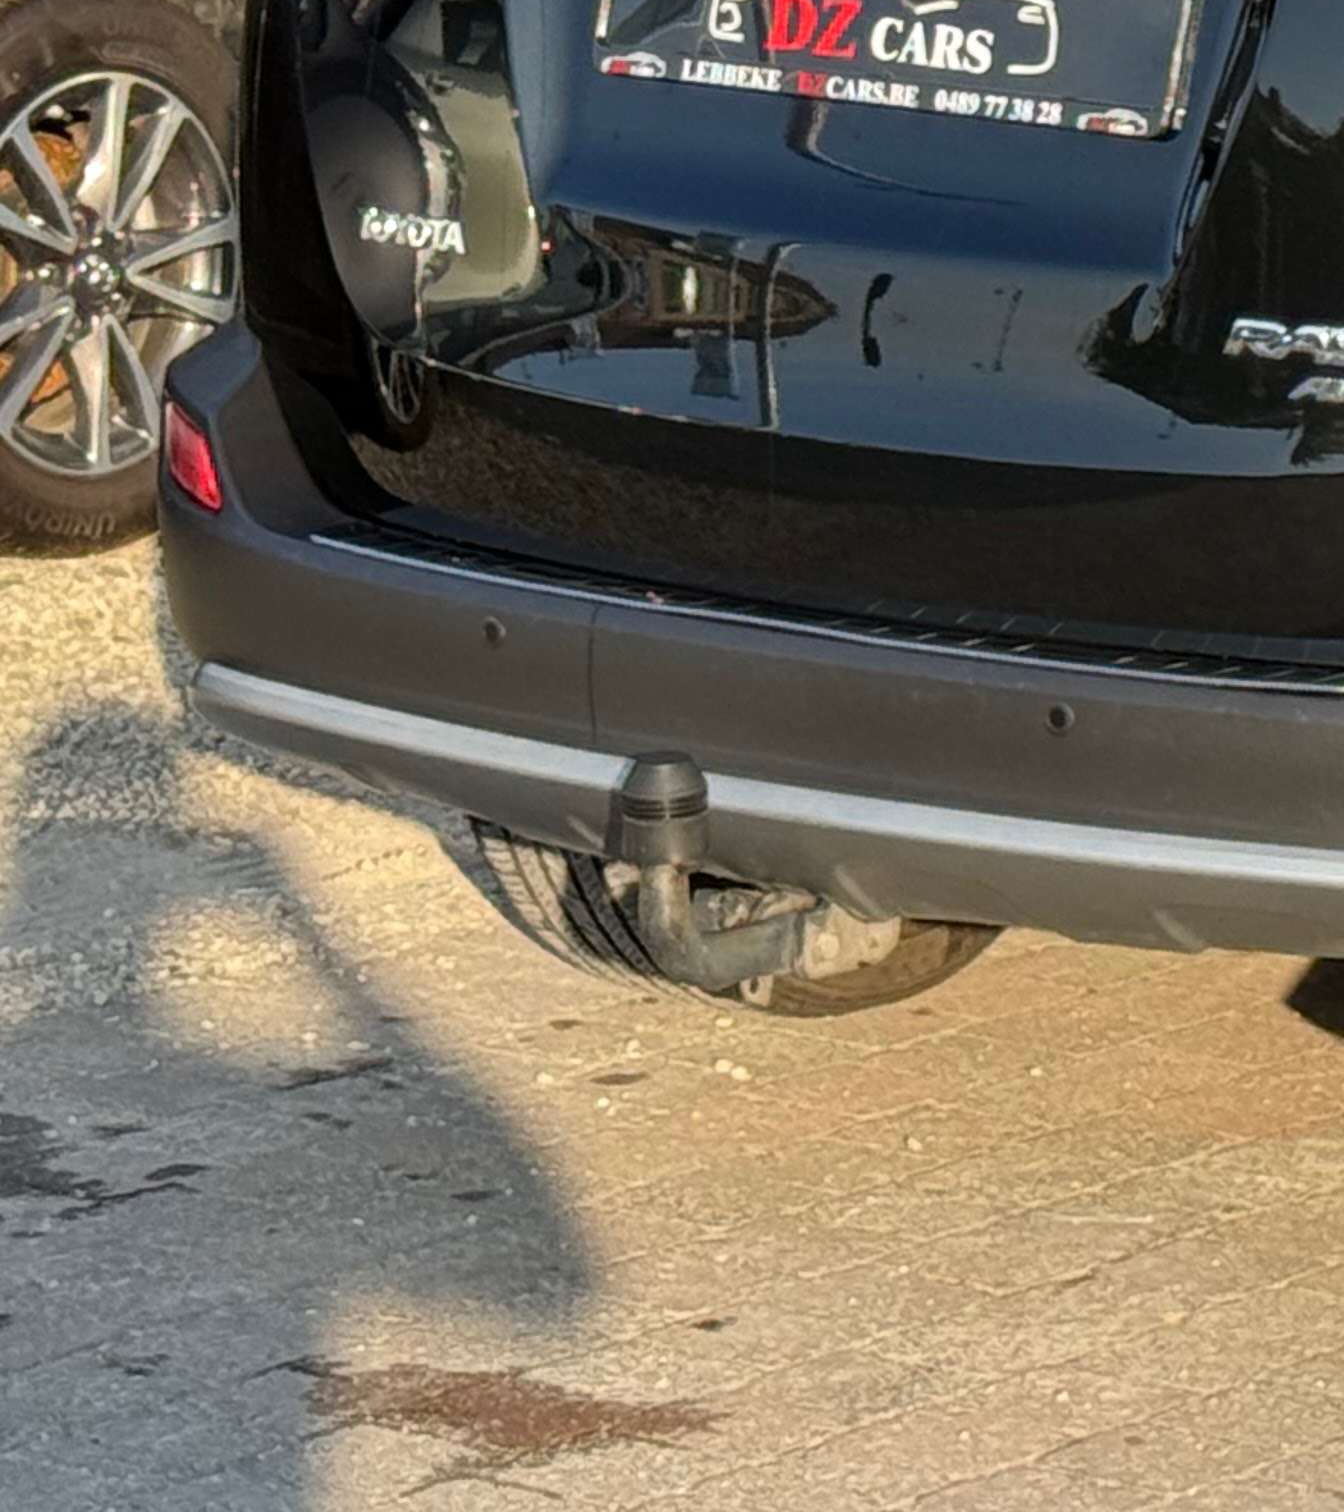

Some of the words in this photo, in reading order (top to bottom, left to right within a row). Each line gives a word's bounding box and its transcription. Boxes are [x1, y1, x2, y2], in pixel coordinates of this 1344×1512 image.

[869, 16, 995, 75] CARS
[681, 58, 783, 92] LEBBEKE
[934, 88, 980, 115] 0489
[984, 94, 1008, 119] 77
[1008, 97, 1035, 123] 38
[1035, 101, 1063, 125] 28
[358, 206, 466, 256] TOYOTA
